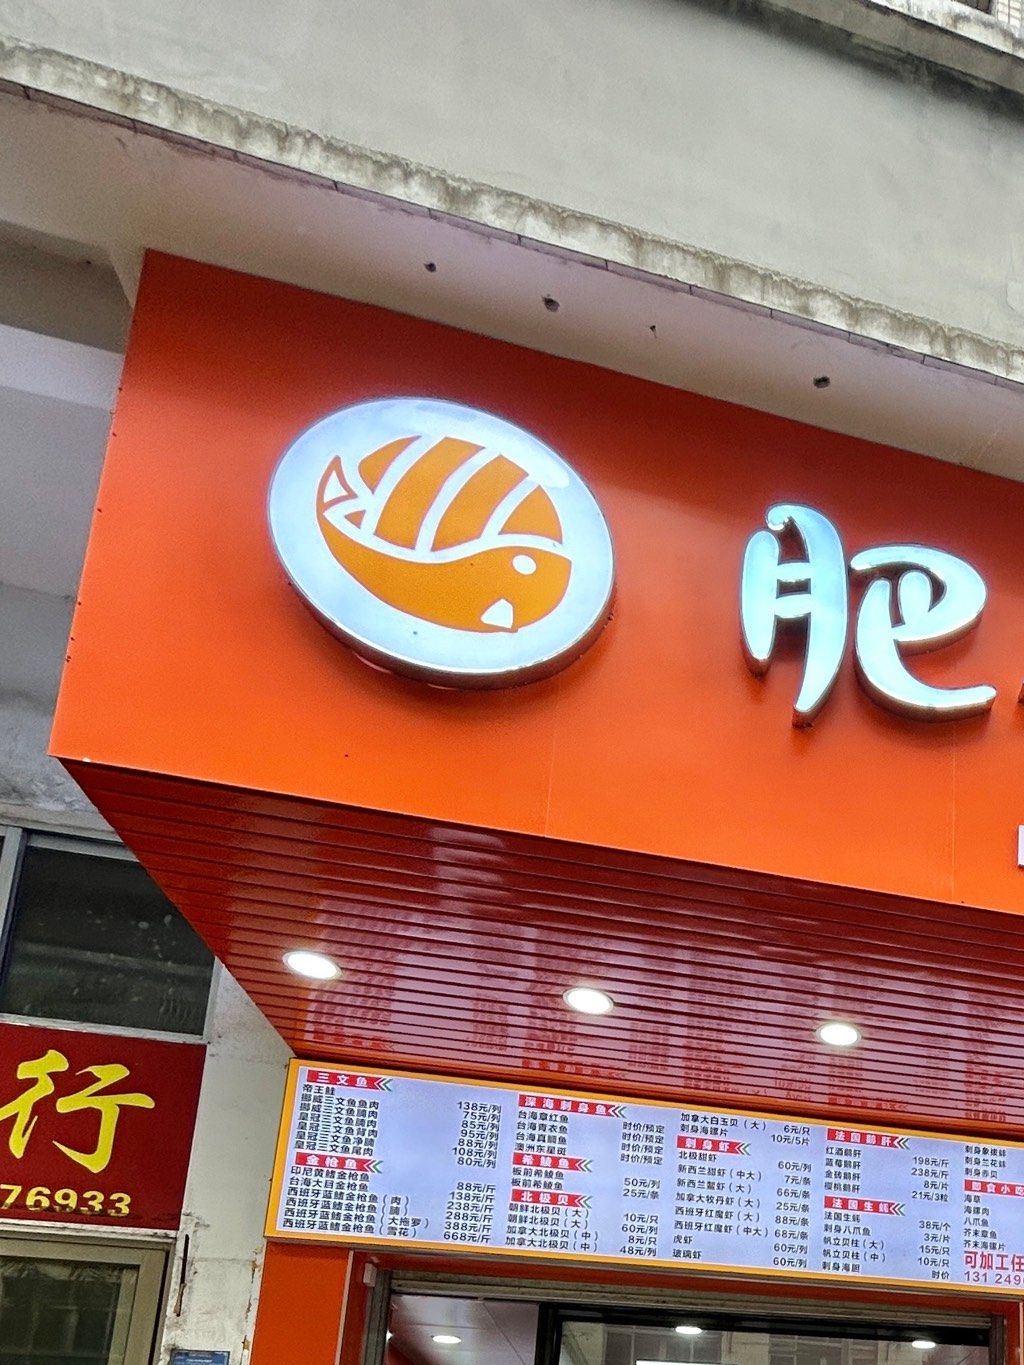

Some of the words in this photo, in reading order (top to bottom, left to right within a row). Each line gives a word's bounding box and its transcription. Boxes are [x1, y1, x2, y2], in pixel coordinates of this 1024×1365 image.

[316, 1073, 368, 1087] 三文鱼
[0, 1049, 155, 1173] 行
[305, 1155, 358, 1169] 金枪鱼
[521, 1191, 569, 1204] 北极贝
[964, 1271, 987, 1282] 131
